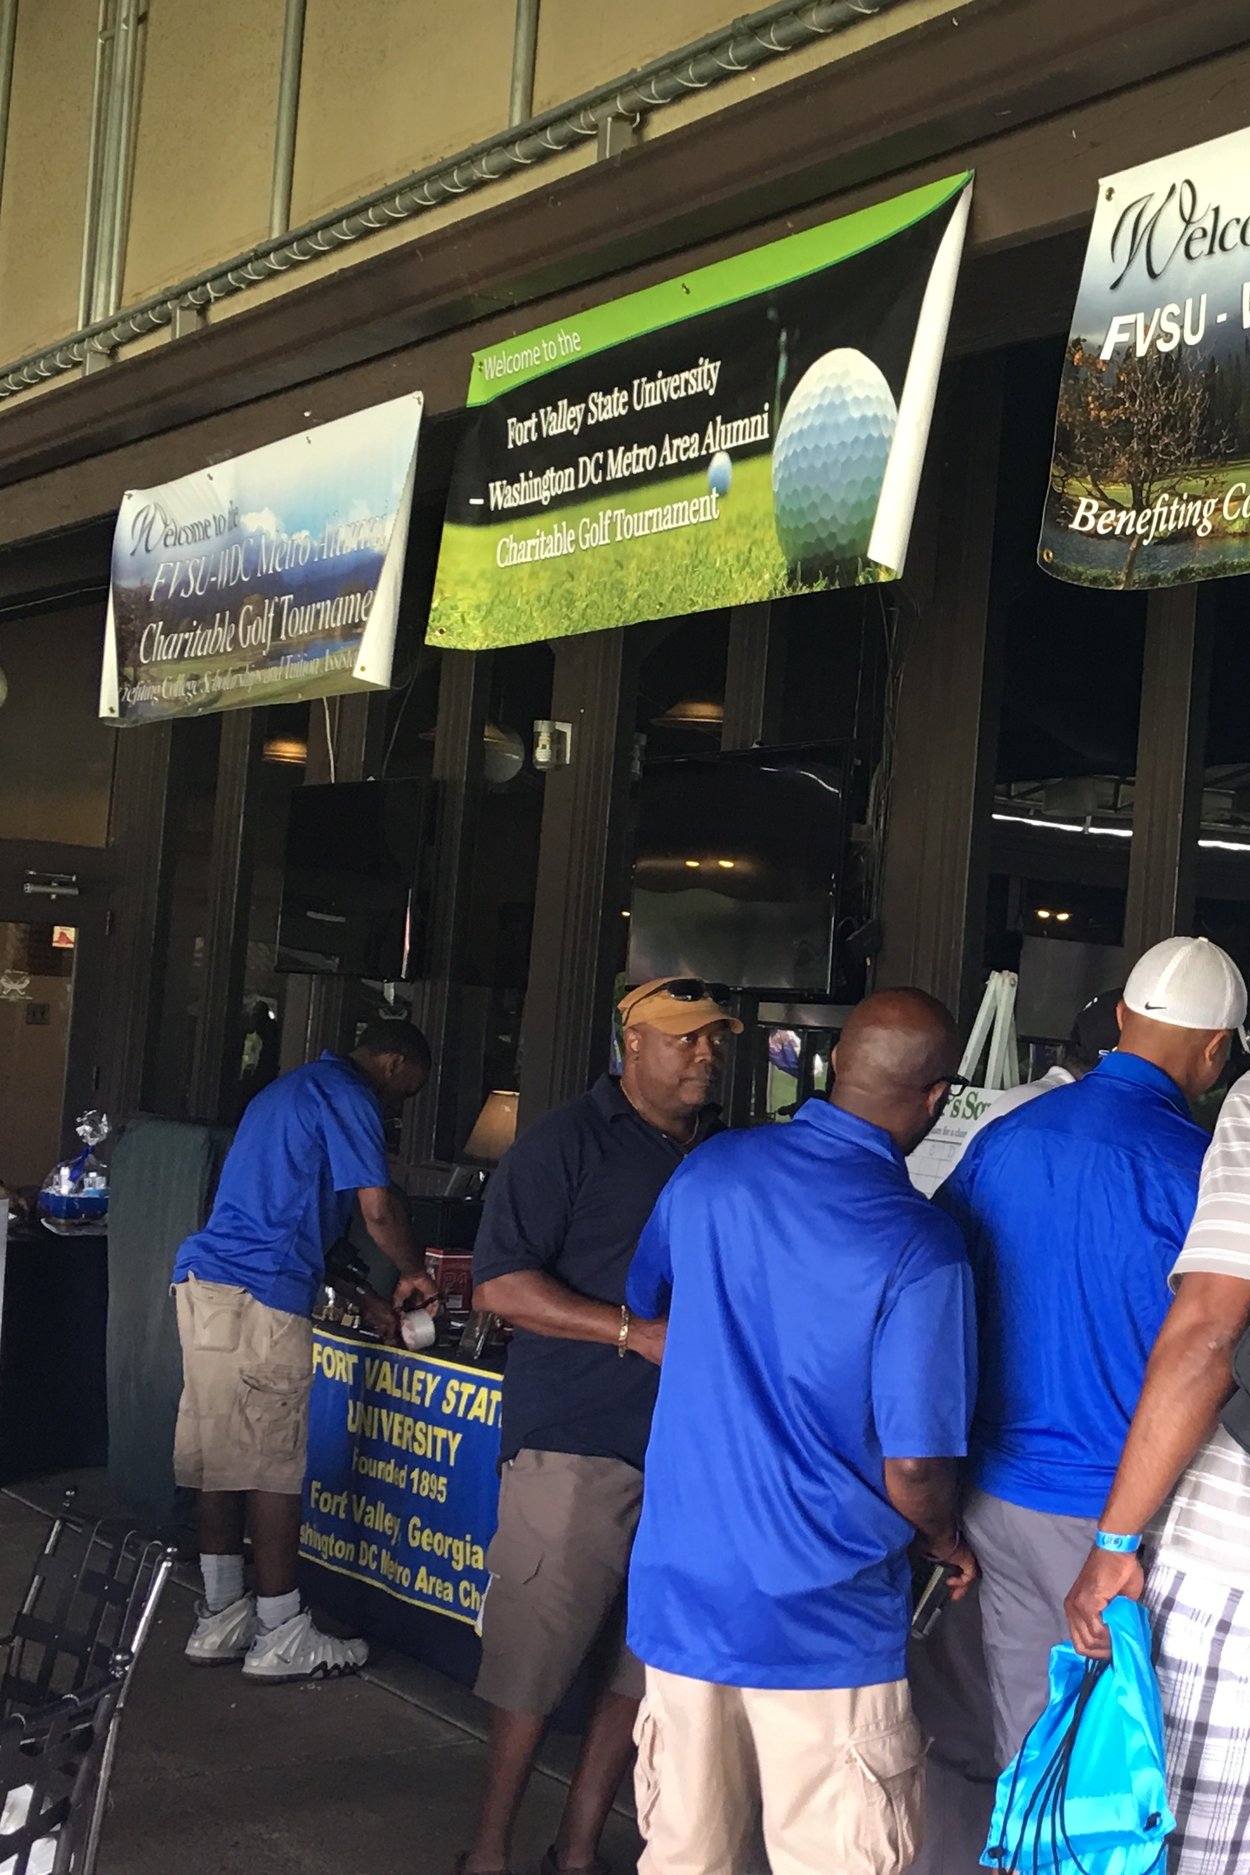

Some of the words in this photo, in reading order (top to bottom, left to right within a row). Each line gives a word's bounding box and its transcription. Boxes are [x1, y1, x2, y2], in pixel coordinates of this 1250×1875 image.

[483, 342, 540, 380] Welcome
[541, 338, 556, 363] to
[558, 329, 581, 358] the
[1100, 294, 1207, 361] FVSU
[507, 416, 537, 449] Fort
[539, 399, 586, 443] Valley
[587, 386, 628, 426] State
[633, 357, 721, 411] University
[489, 464, 575, 511] Washington
[578, 453, 603, 488] DC
[606, 443, 656, 481] Metro
[659, 433, 699, 467] Area
[701, 402, 770, 455] Alumni
[130, 502, 211, 556] Welcome
[496, 523, 575, 568] Charitable
[578, 512, 611, 550] Golf
[613, 487, 720, 544] Tournament
[1069, 496, 1215, 546] Benefiting
[139, 612, 235, 664] Charitable
[238, 599, 281, 656] Golf
[313, 1342, 359, 1386] FORT
[364, 1357, 442, 1409] VALLEY
[346, 1399, 464, 1467] UNIVERSITY
[352, 1447, 407, 1489] Founded
[410, 1467, 448, 1504] 1895
[310, 1480, 347, 1519] Fort
[407, 1515, 485, 1572] Georgia
[358, 1540, 378, 1571] DC
[380, 1548, 411, 1588] Metro
[414, 1565, 453, 1604] Area
